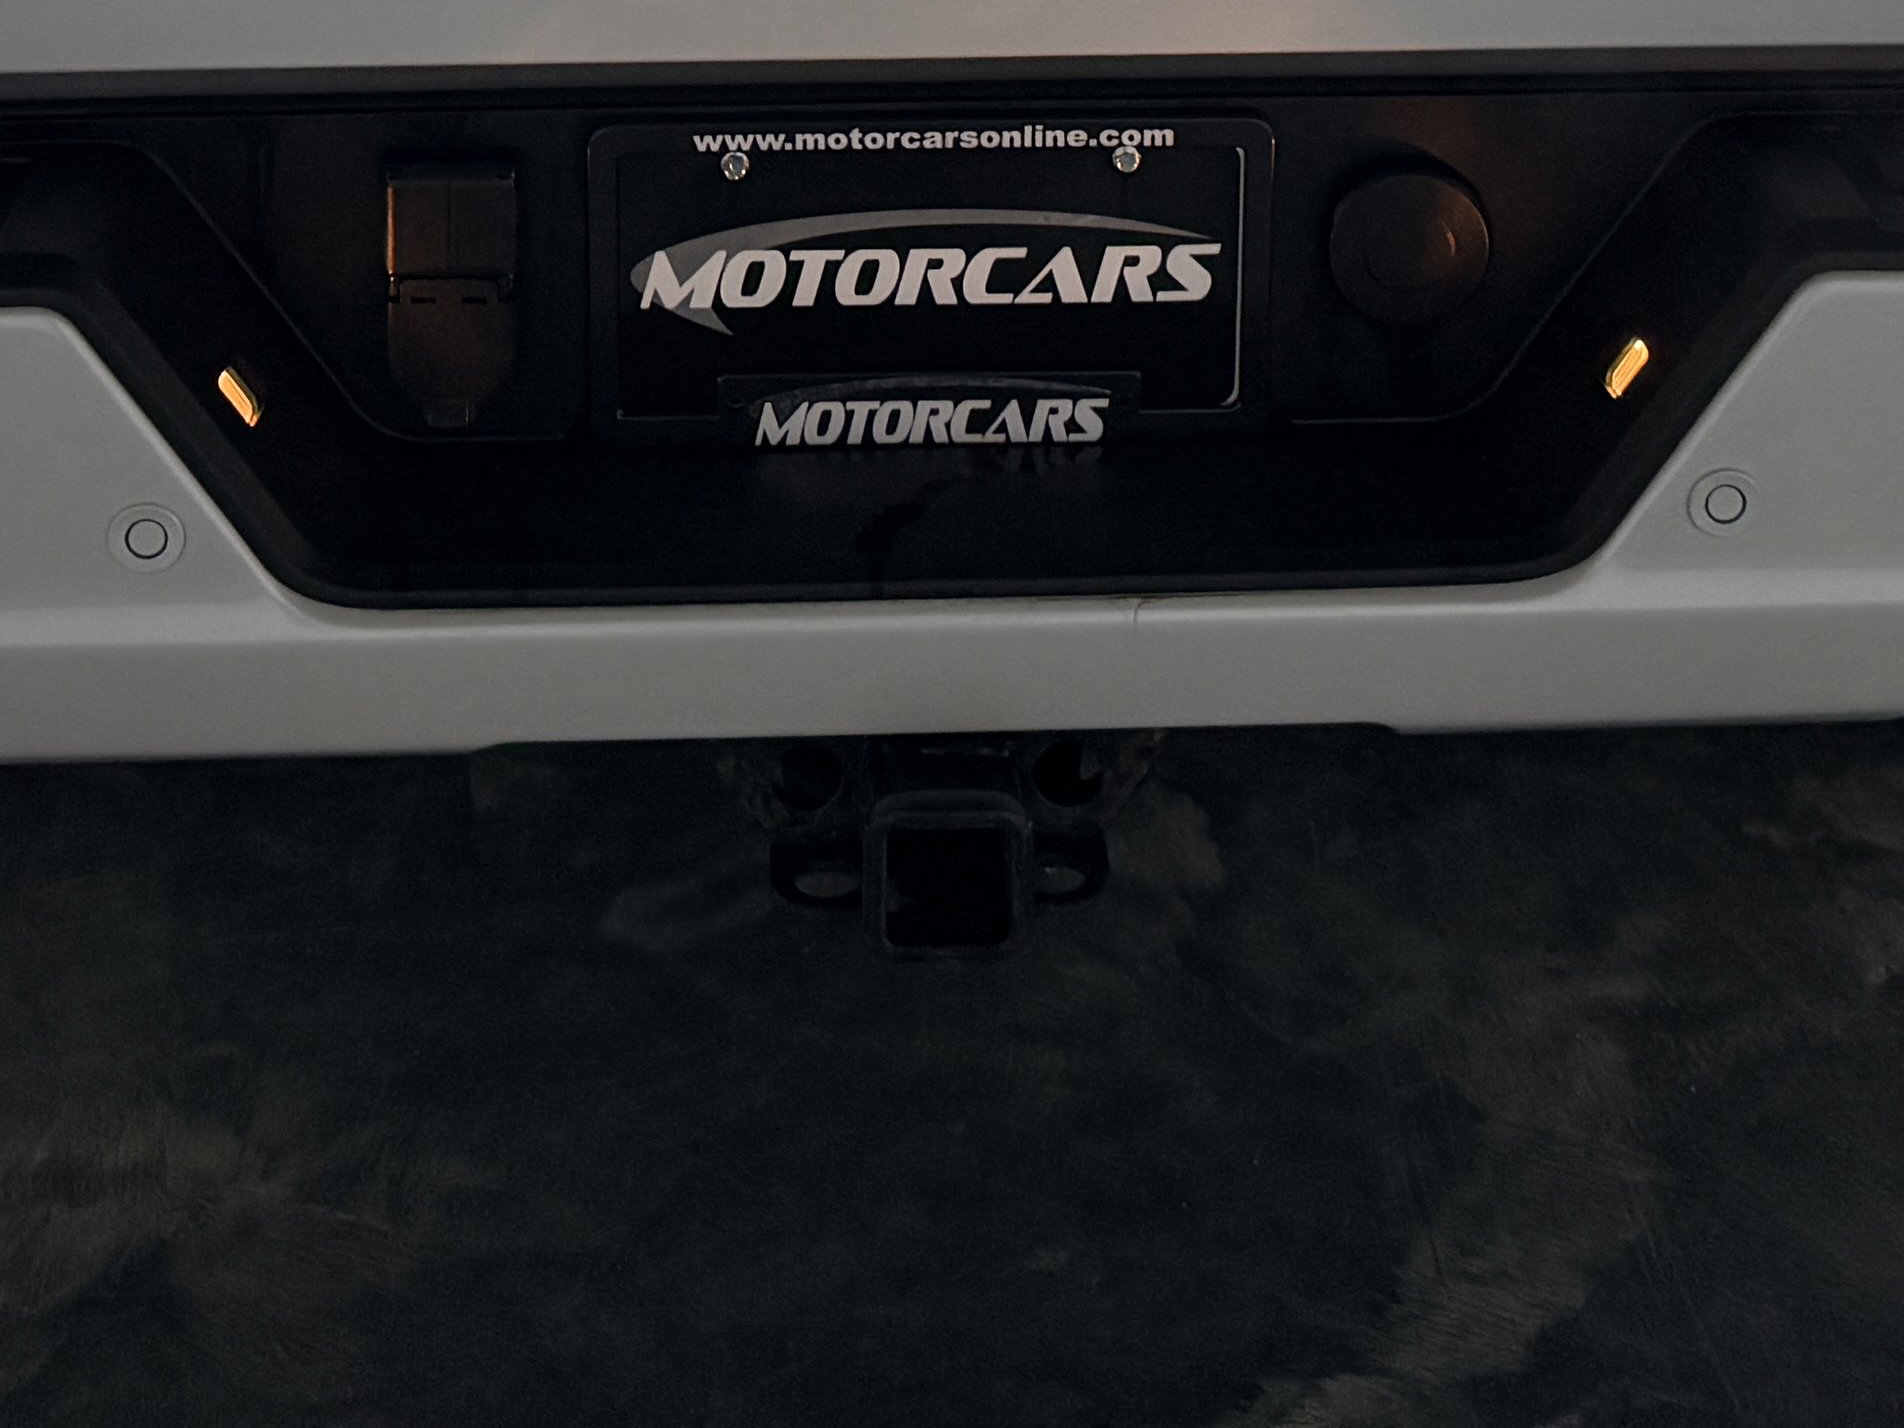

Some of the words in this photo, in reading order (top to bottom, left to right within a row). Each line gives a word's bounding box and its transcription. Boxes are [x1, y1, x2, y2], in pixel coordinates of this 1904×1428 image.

[693, 125, 1174, 152] www.motorcarsonline.com
[640, 243, 1221, 309] MOTORCARS
[754, 398, 1110, 446] MOTORCARS
